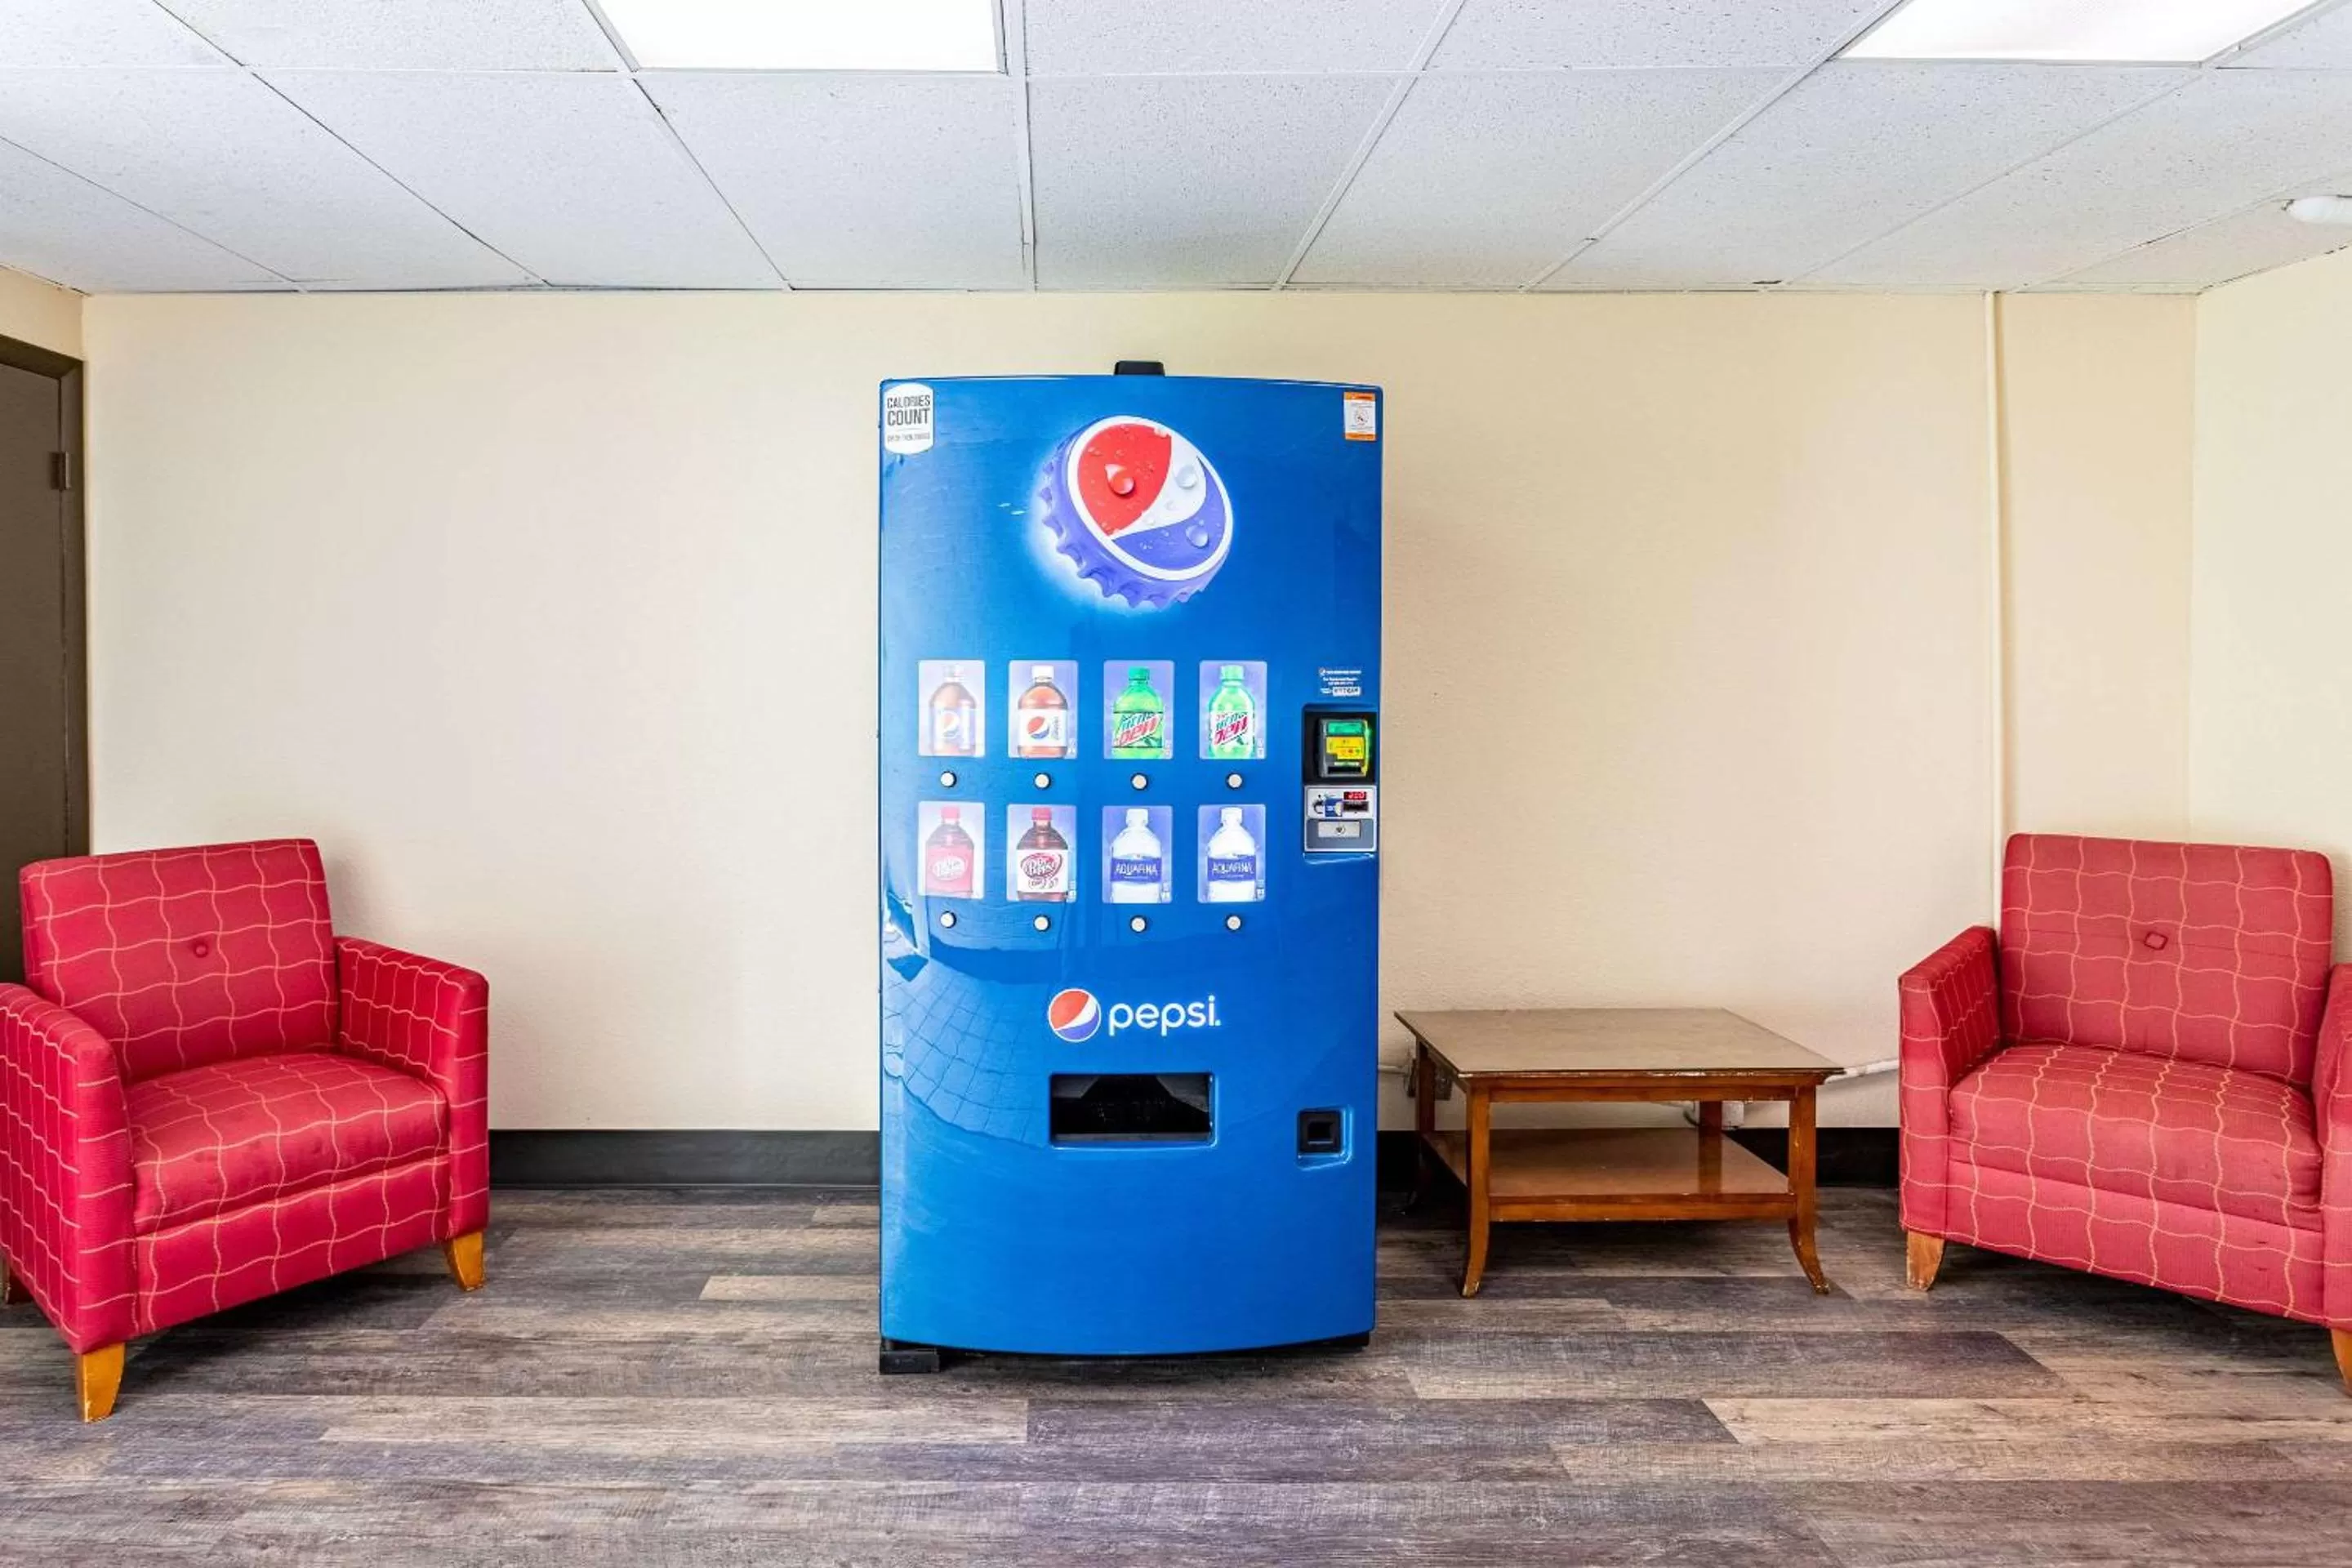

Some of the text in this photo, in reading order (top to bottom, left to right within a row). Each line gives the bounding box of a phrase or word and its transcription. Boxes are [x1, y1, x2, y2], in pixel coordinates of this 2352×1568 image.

[887, 394, 931, 409] CALORIES
[887, 408, 931, 426] COUNT
[1116, 862, 1158, 876] AQUAFINA
[1212, 862, 1254, 875] AQUAFINA
